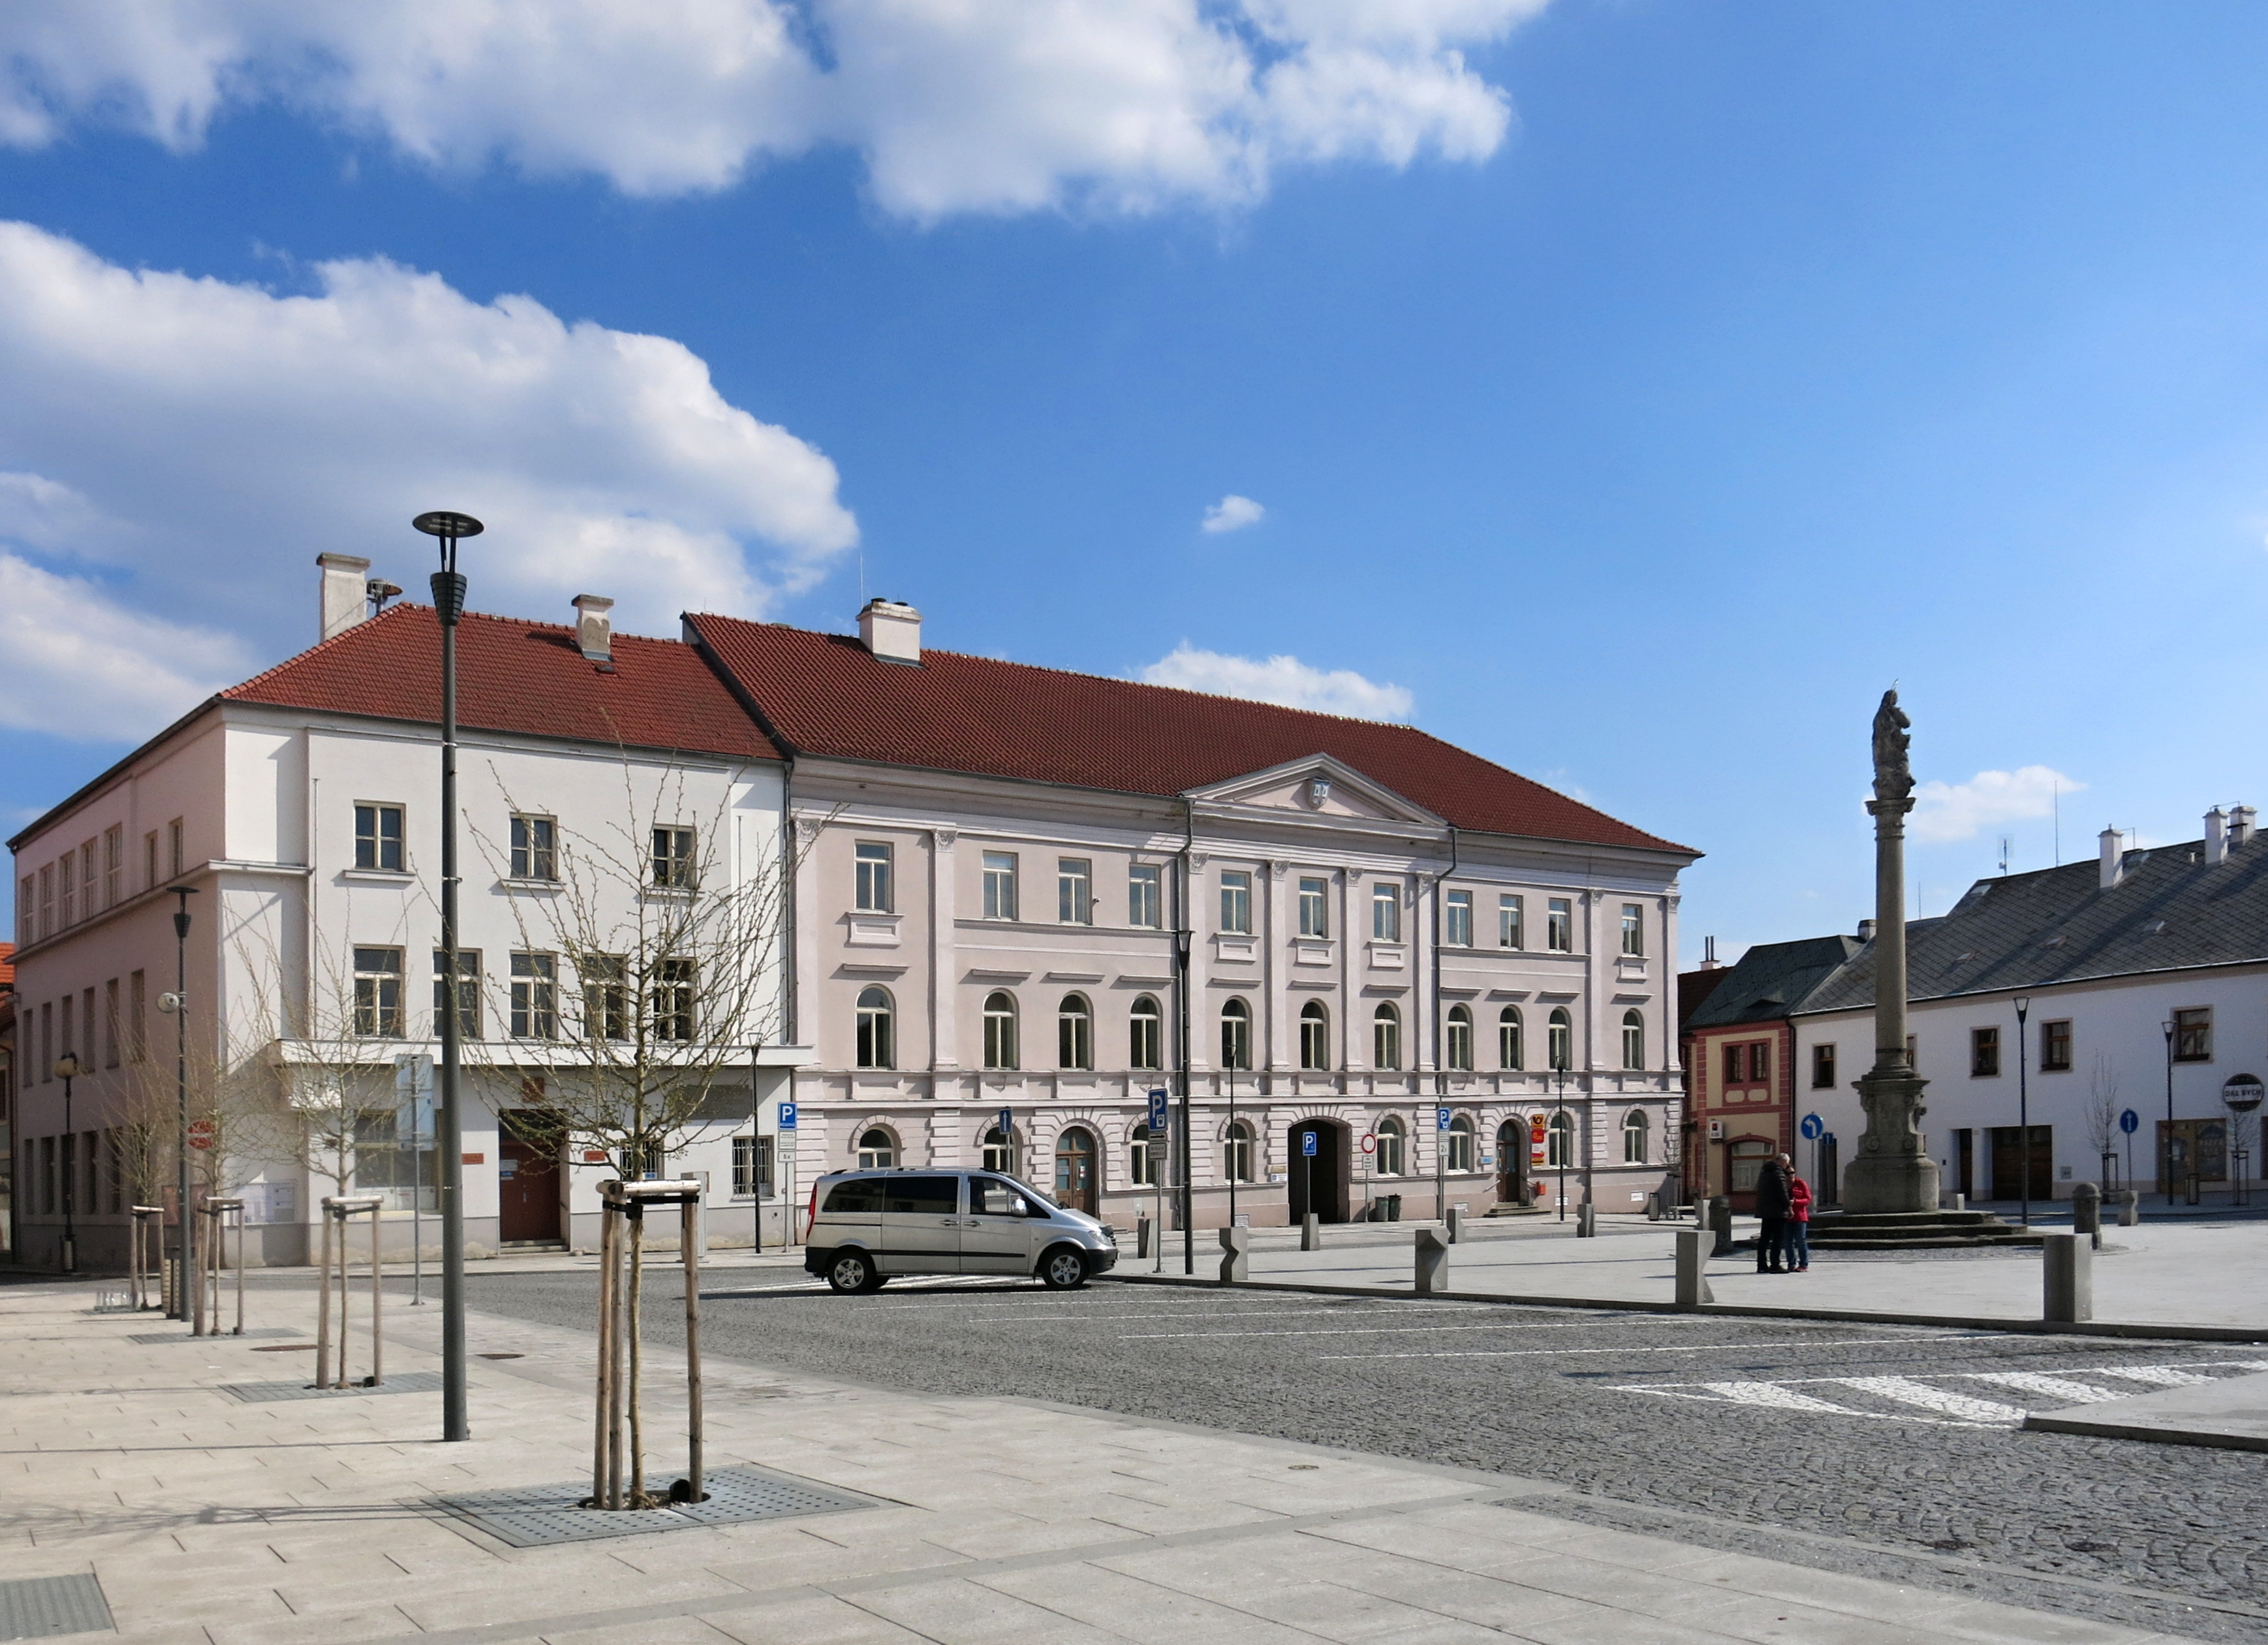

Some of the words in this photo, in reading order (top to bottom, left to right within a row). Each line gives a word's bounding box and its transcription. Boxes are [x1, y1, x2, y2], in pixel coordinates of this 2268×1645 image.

[782, 1105, 793, 1121] P
[1152, 1095, 1163, 1119] P
[1440, 1111, 1448, 1123] P
[1305, 1135, 1314, 1149] P
